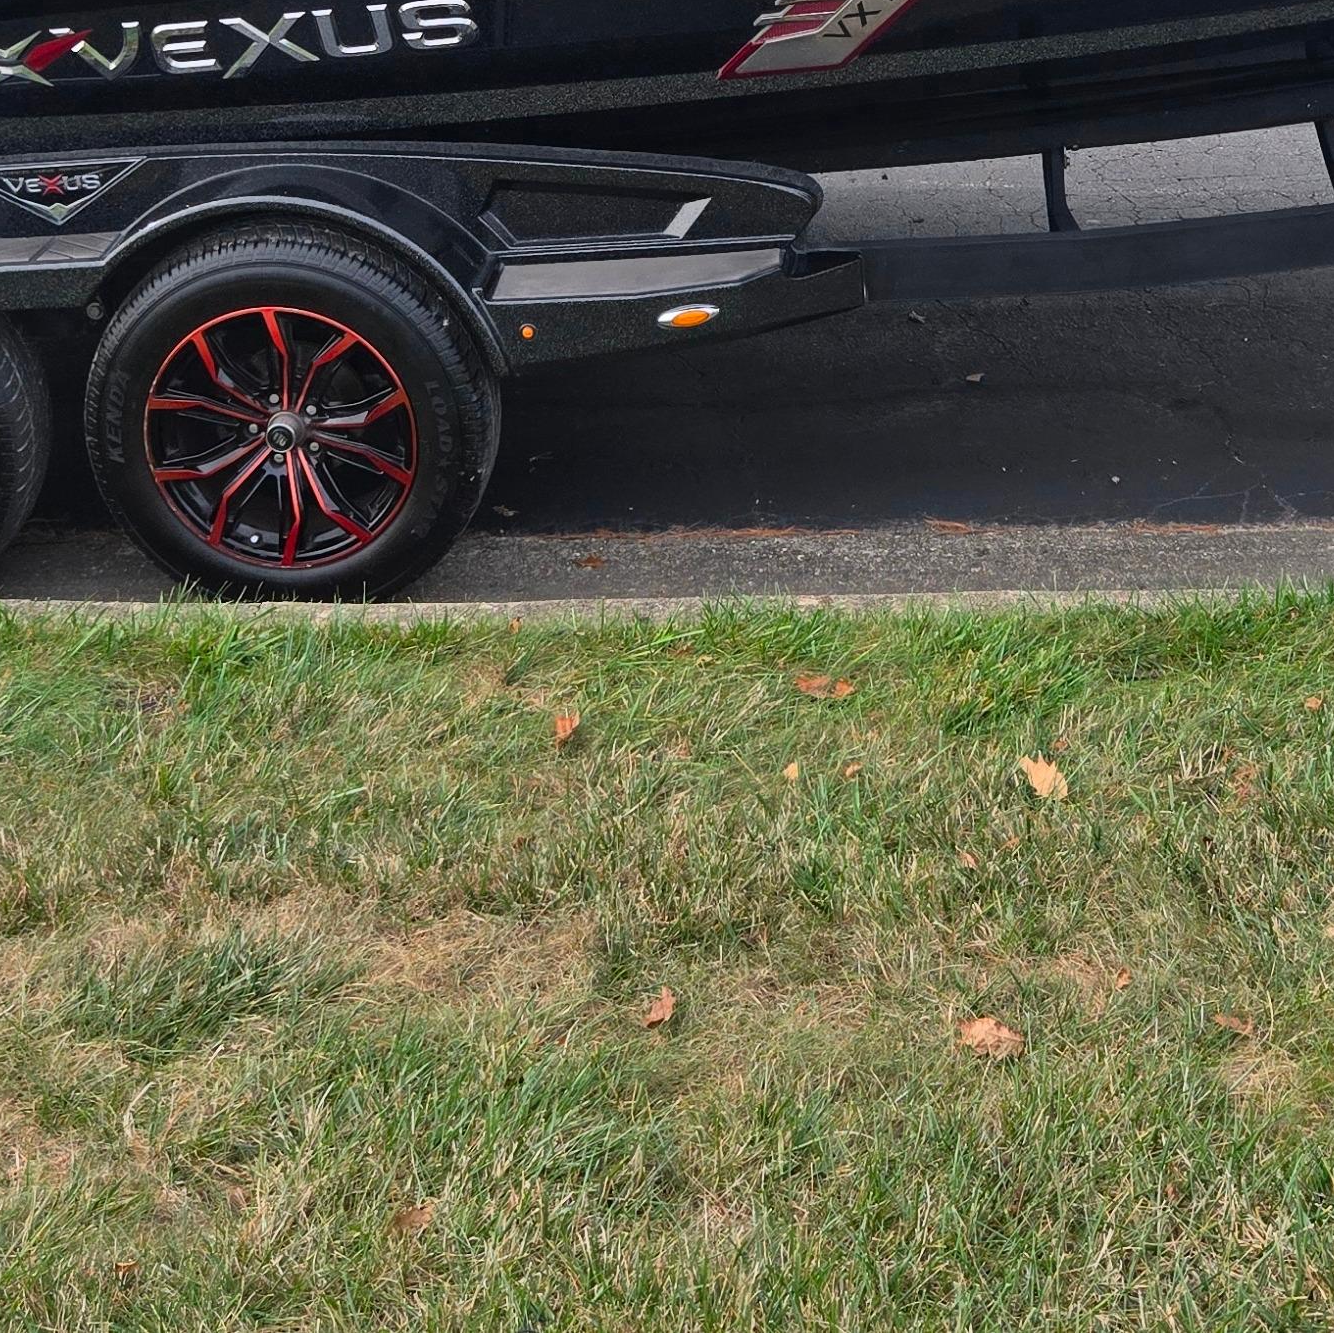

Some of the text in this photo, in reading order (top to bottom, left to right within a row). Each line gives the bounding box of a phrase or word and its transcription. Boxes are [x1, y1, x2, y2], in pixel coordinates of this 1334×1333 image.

[821, 0, 882, 38] VX
[3, 173, 102, 196] VEXUS
[103, 366, 133, 466] KENDA
